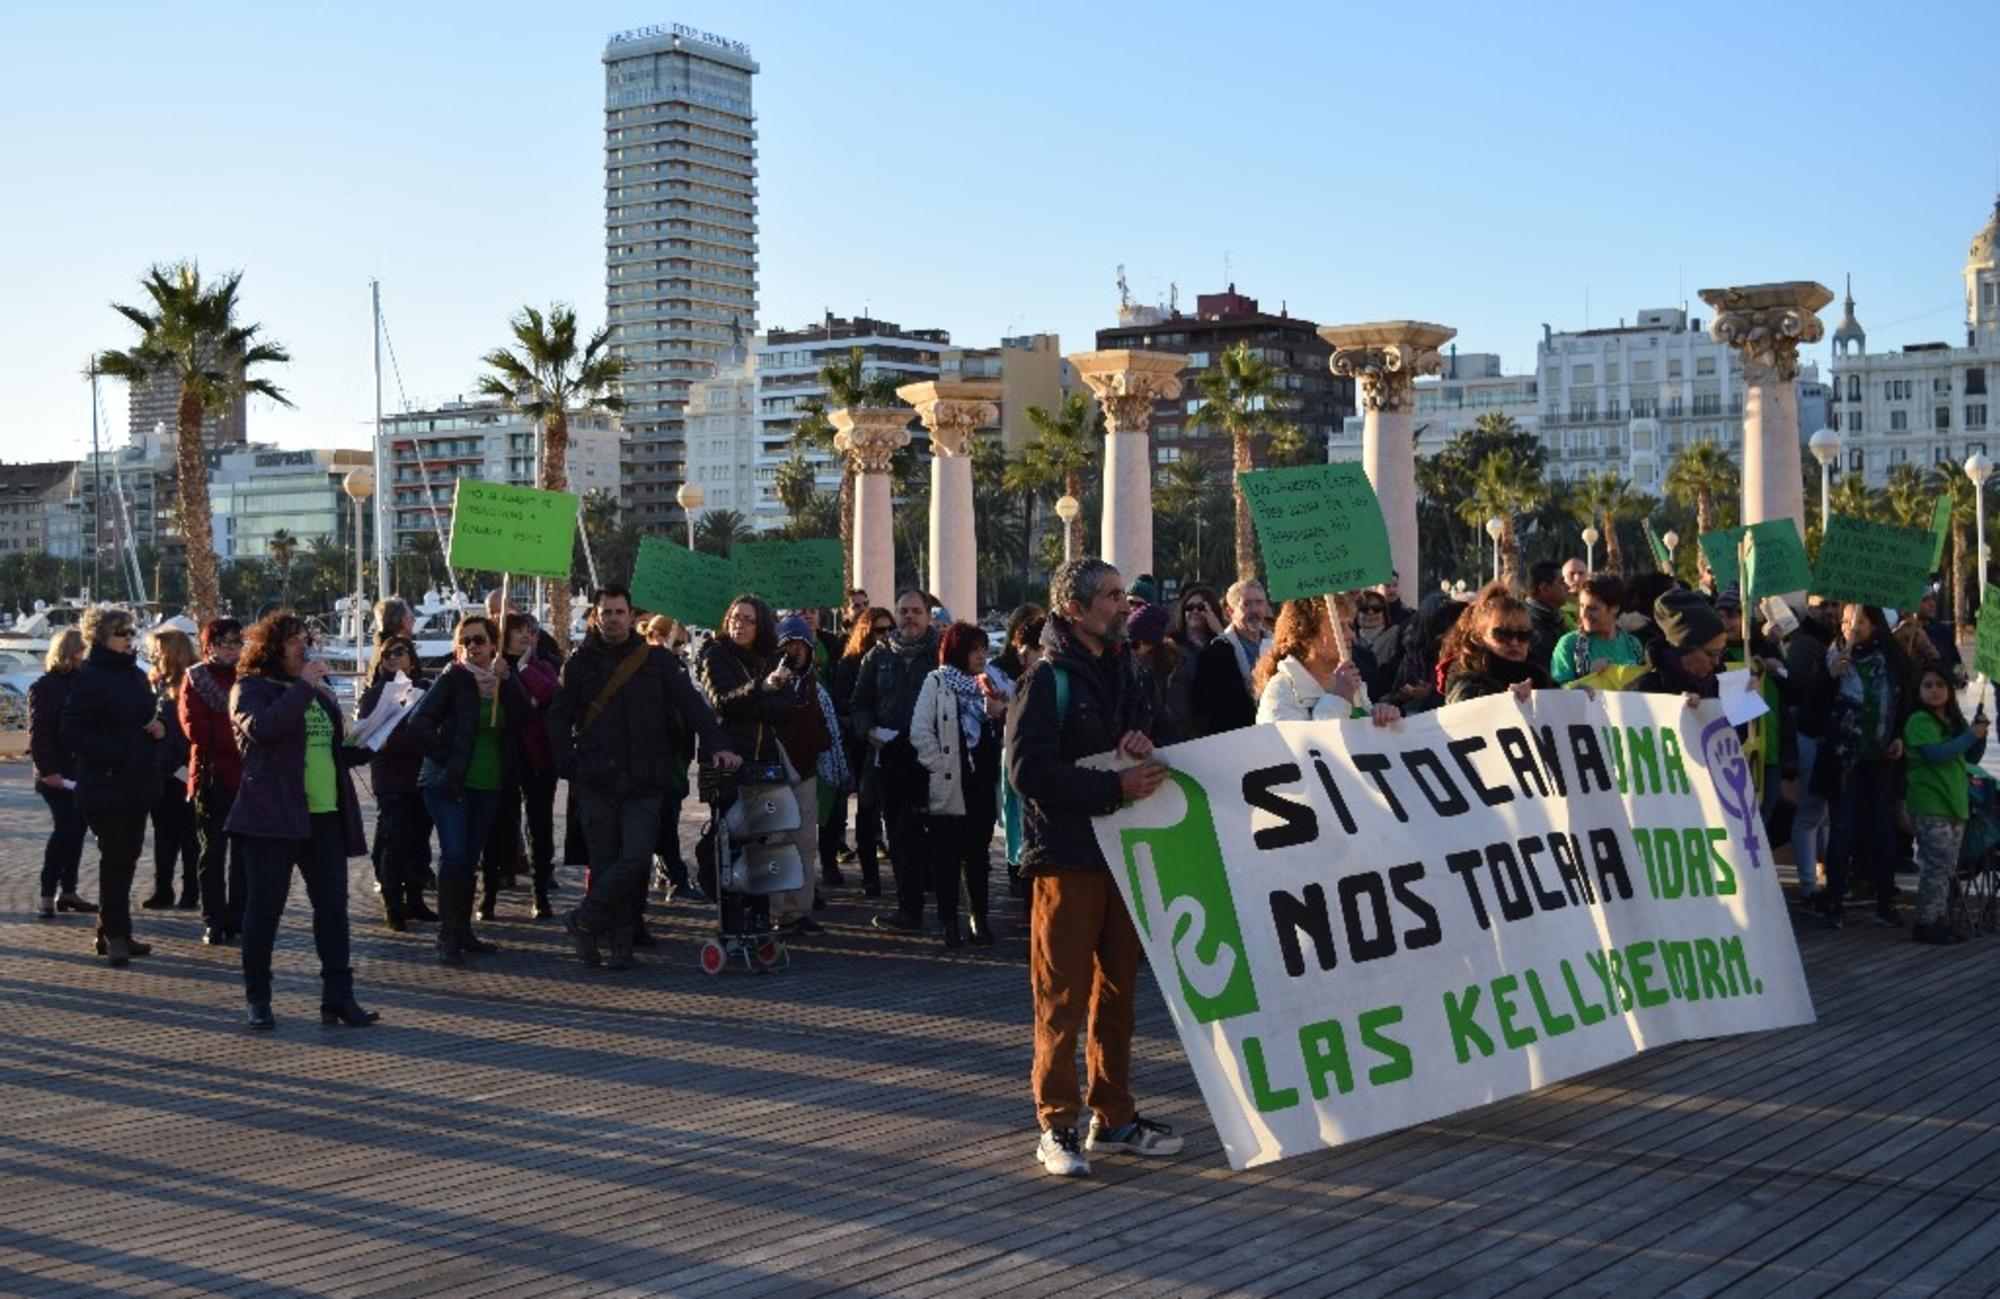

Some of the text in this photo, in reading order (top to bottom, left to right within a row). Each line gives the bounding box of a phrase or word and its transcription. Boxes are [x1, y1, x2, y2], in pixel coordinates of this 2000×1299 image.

[1351, 724, 1567, 822] TOCAN
[1567, 724, 1612, 794] A
[1601, 725, 1690, 796] UNA
[1268, 861, 1442, 977] NOS
[1588, 827, 1633, 902] A
[1242, 1004, 1413, 1112] LAS
